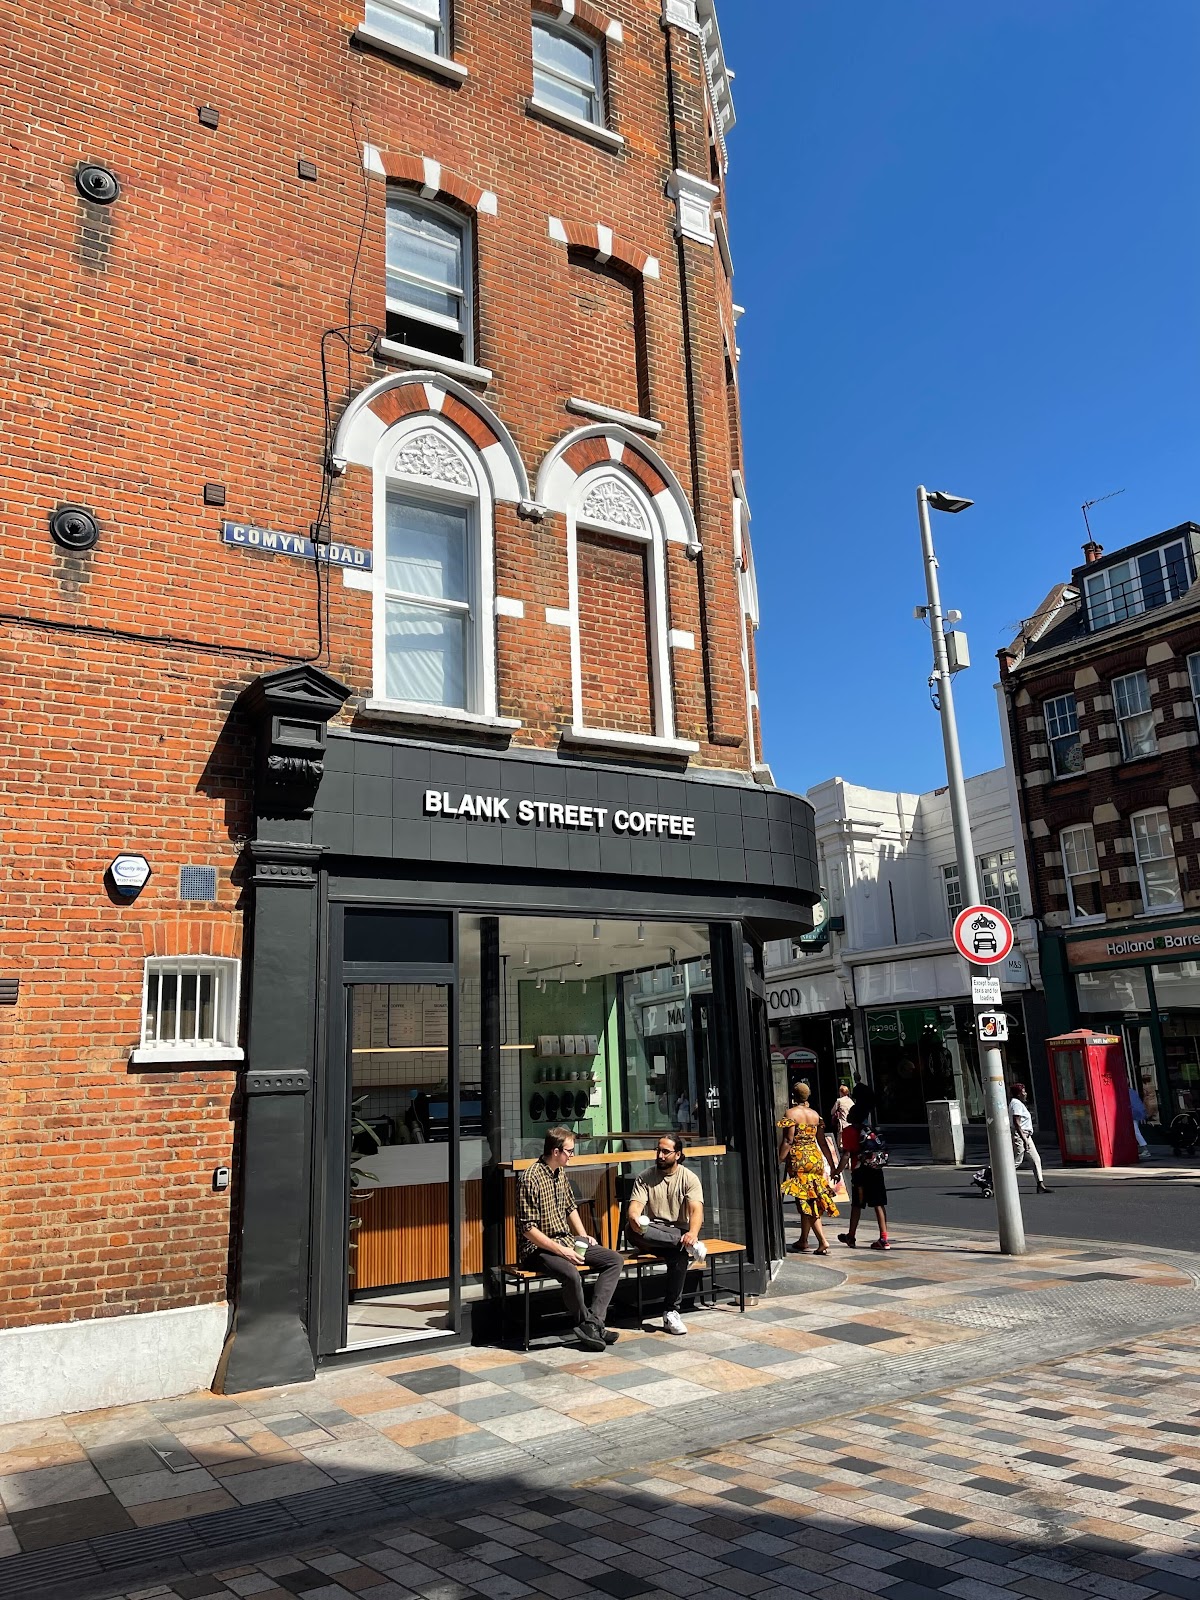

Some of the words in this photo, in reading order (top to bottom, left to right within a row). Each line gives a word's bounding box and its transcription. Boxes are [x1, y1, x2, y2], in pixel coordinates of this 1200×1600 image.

[233, 526, 305, 554] COMYN
[317, 543, 365, 565] ROAD
[425, 790, 510, 819] BLANK
[517, 800, 608, 828] STREET
[614, 810, 696, 836] COFFEE
[1106, 937, 1155, 955] Holland
[1008, 960, 1022, 969] M&S
[973, 979, 987, 987] Except
